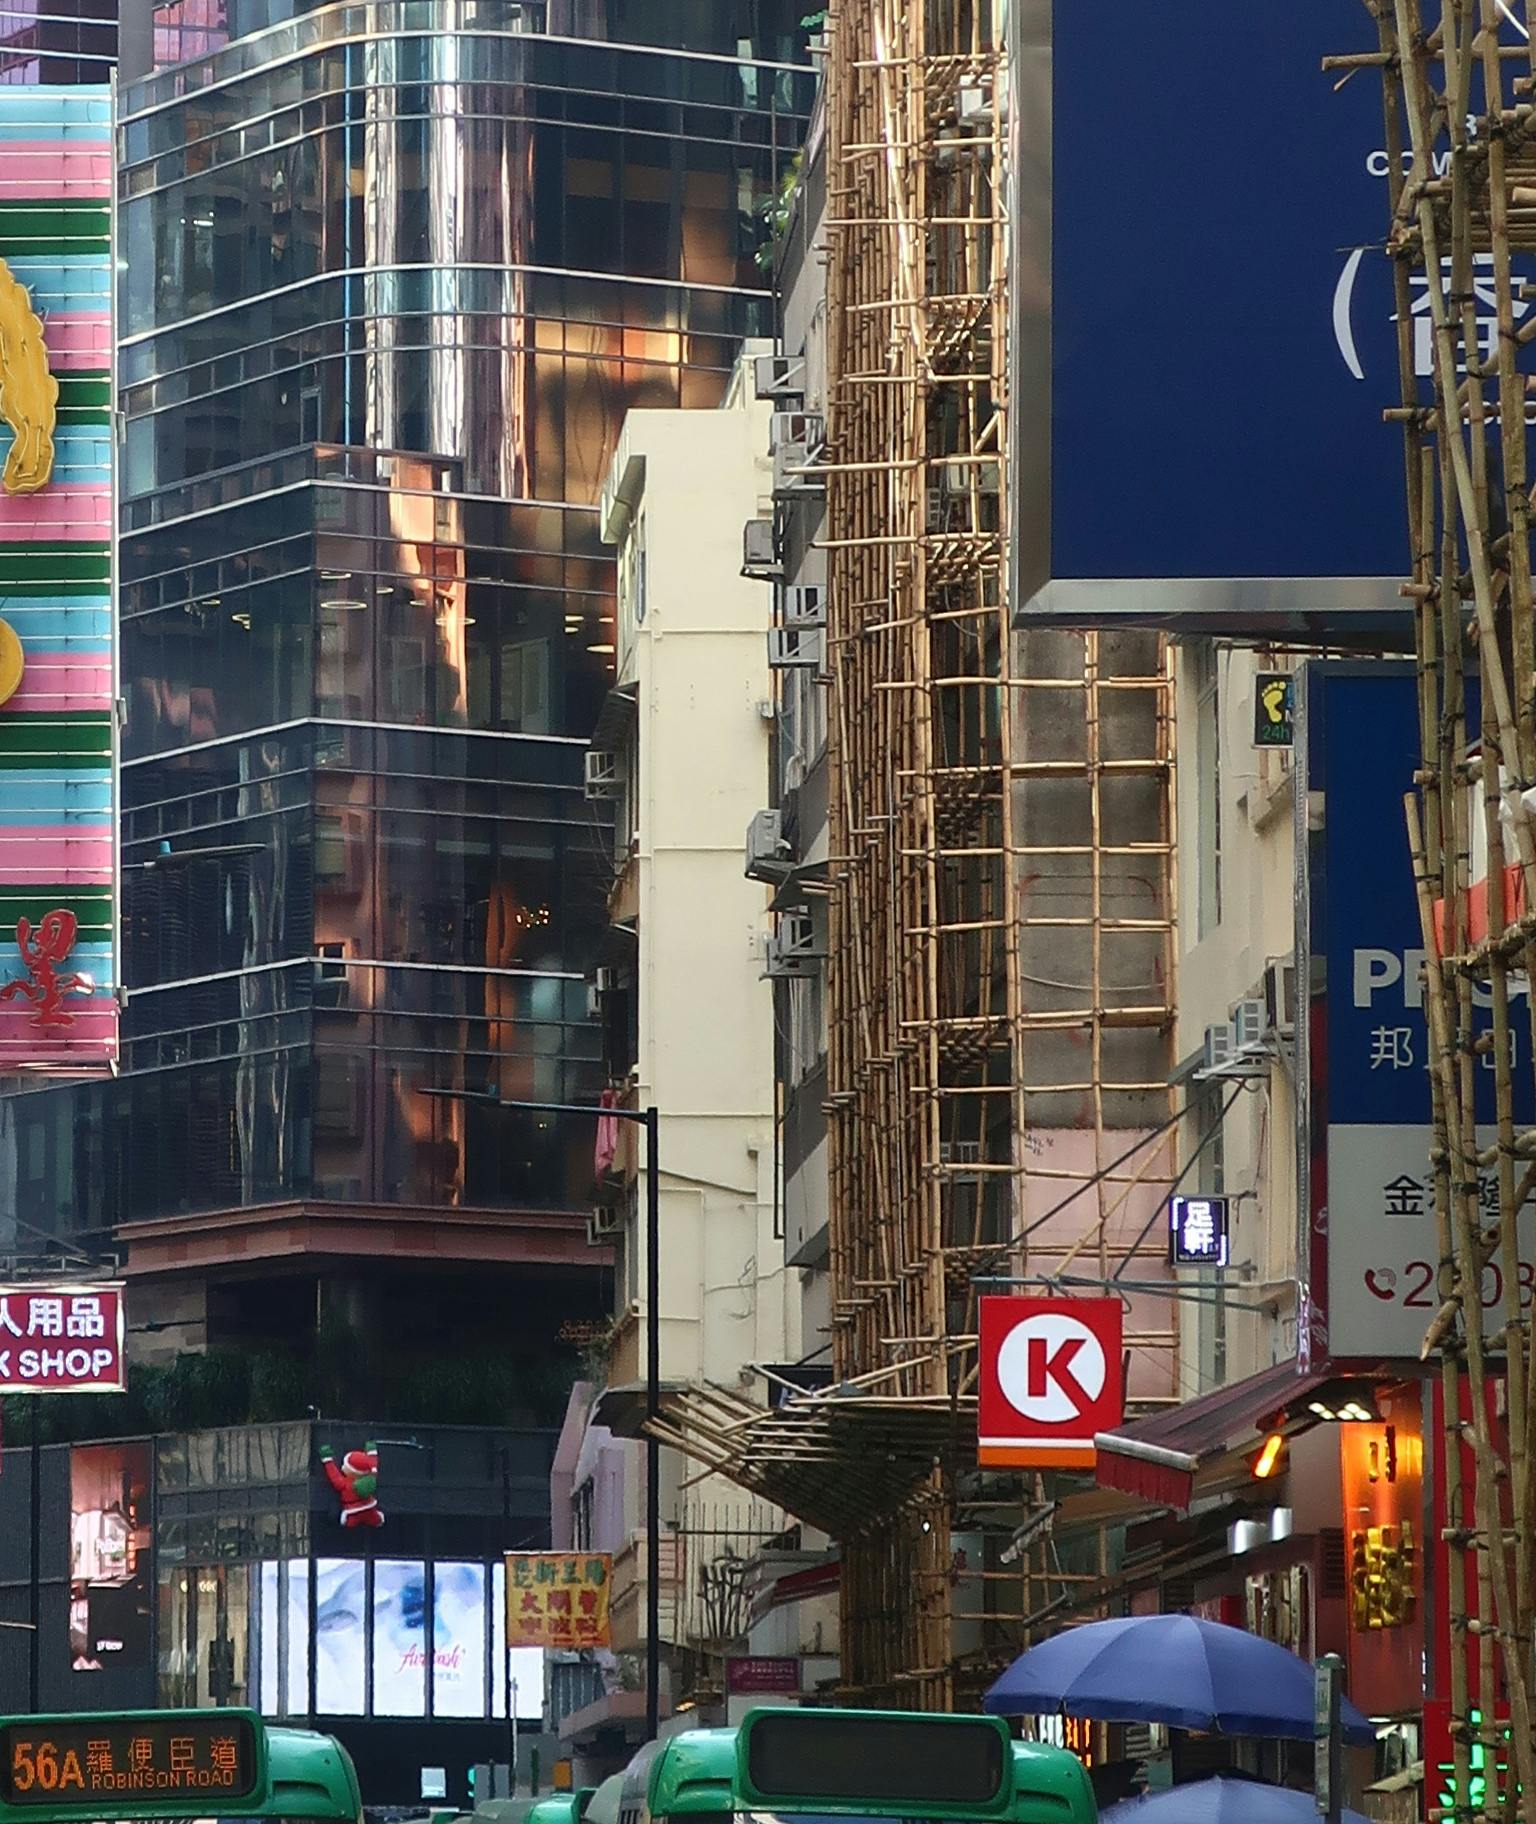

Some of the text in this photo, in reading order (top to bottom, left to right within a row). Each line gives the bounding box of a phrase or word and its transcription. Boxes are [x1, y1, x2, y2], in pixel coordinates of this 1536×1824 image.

[19, 1349, 113, 1378] SHOP
[14, 1741, 85, 1791] 56A
[86, 1736, 238, 1773] 羅便臣道
[91, 1770, 234, 1791] ROBINSON ROAD
